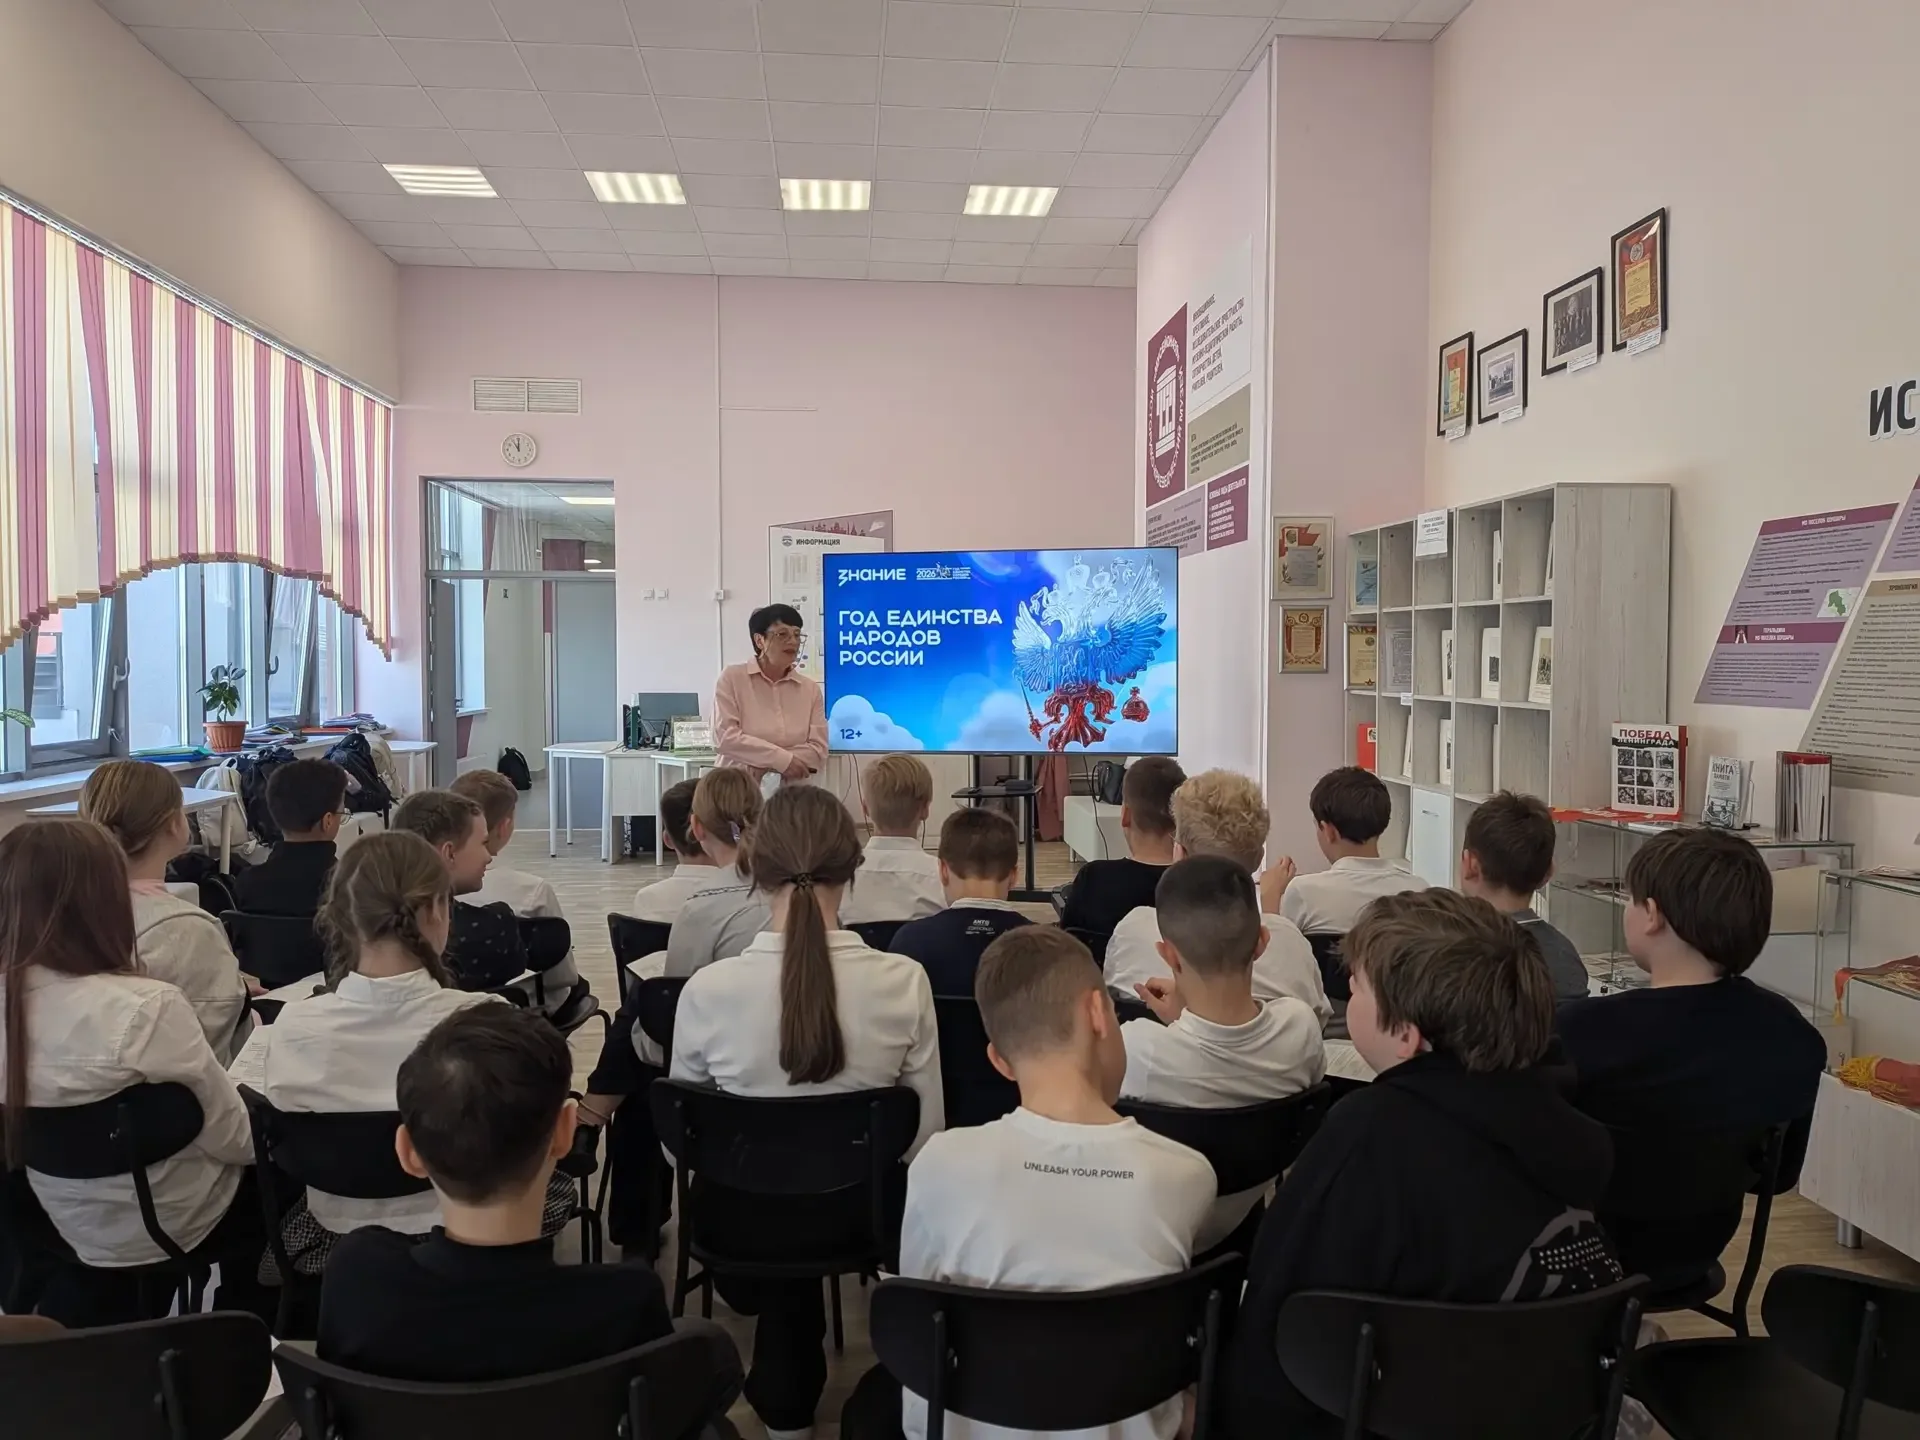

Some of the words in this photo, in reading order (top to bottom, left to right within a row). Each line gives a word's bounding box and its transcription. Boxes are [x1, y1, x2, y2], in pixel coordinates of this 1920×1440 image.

[795, 537, 841, 547] ИНФОРМАЦИЯ
[916, 569, 937, 579] 2026
[838, 610, 881, 628] ГОД
[887, 608, 1003, 628] ЕДИНСТВА
[839, 629, 942, 648] НАРОДОВ
[839, 649, 924, 666] РОССИИ
[840, 728, 863, 740] 12+
[1619, 729, 1672, 741] ПОБЕДА
[1617, 738, 1675, 746] ЛЕНИНГРАДА
[1712, 763, 1734, 775] КНИГА
[1024, 1160, 1069, 1176] UNLEASH
[1071, 1167, 1098, 1178] YOUR
[1100, 1169, 1135, 1180] POWER
